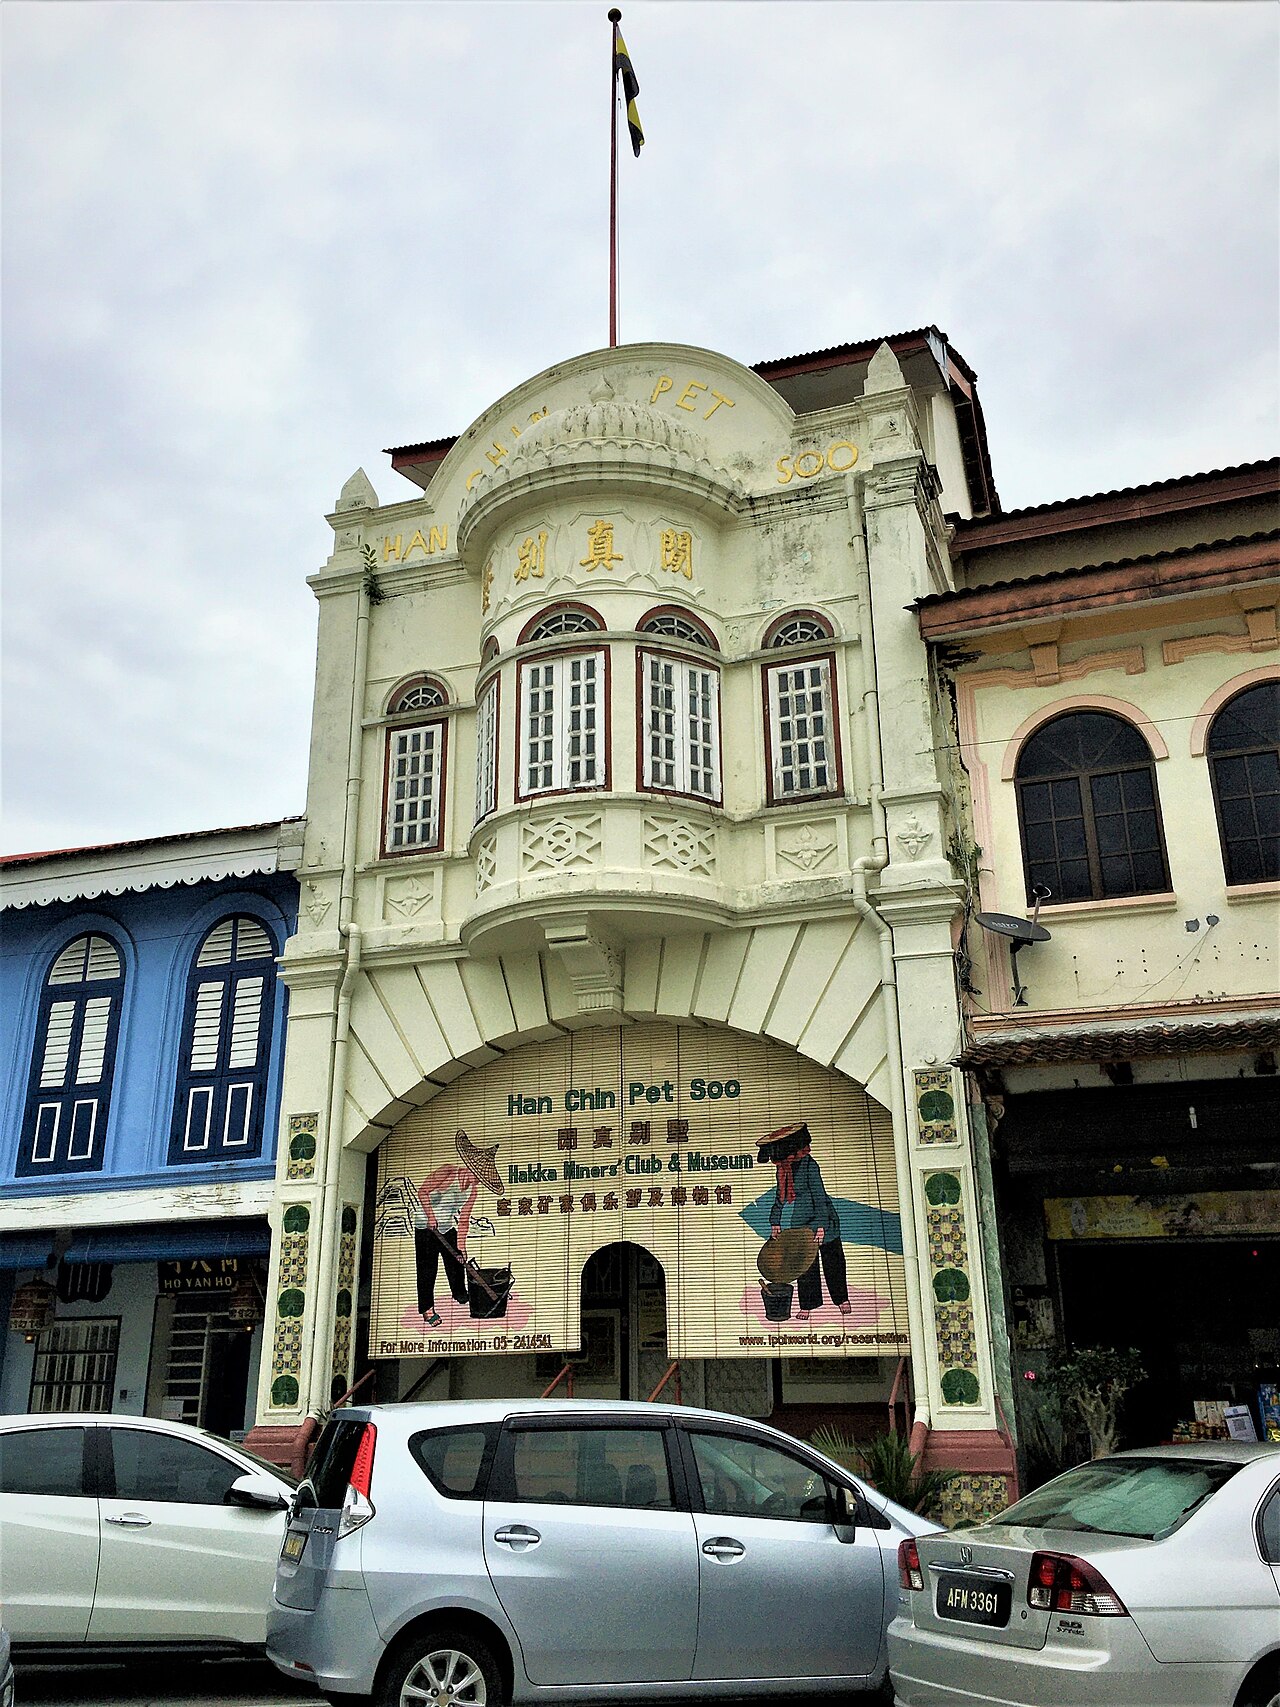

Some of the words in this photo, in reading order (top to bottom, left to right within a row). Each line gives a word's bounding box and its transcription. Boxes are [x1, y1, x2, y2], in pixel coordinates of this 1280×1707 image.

[383, 523, 449, 562] HAN
[650, 374, 735, 420] PET
[775, 441, 859, 484] SOO
[508, 1094, 552, 1116] Han
[565, 1088, 615, 1112] Chin
[629, 1080, 673, 1105] Pet
[690, 1079, 741, 1101] Soo
[508, 1163, 557, 1184] Hakka
[625, 1155, 662, 1175] Club
[668, 1153, 681, 1172] &
[687, 1152, 753, 1172] Museum
[164, 1279, 181, 1289] HO
[186, 1277, 212, 1288] YAN
[381, 1341, 398, 1354] For
[400, 1341, 424, 1353] More
[947, 1588, 968, 1609] AFM
[970, 1591, 998, 1613] 3361
